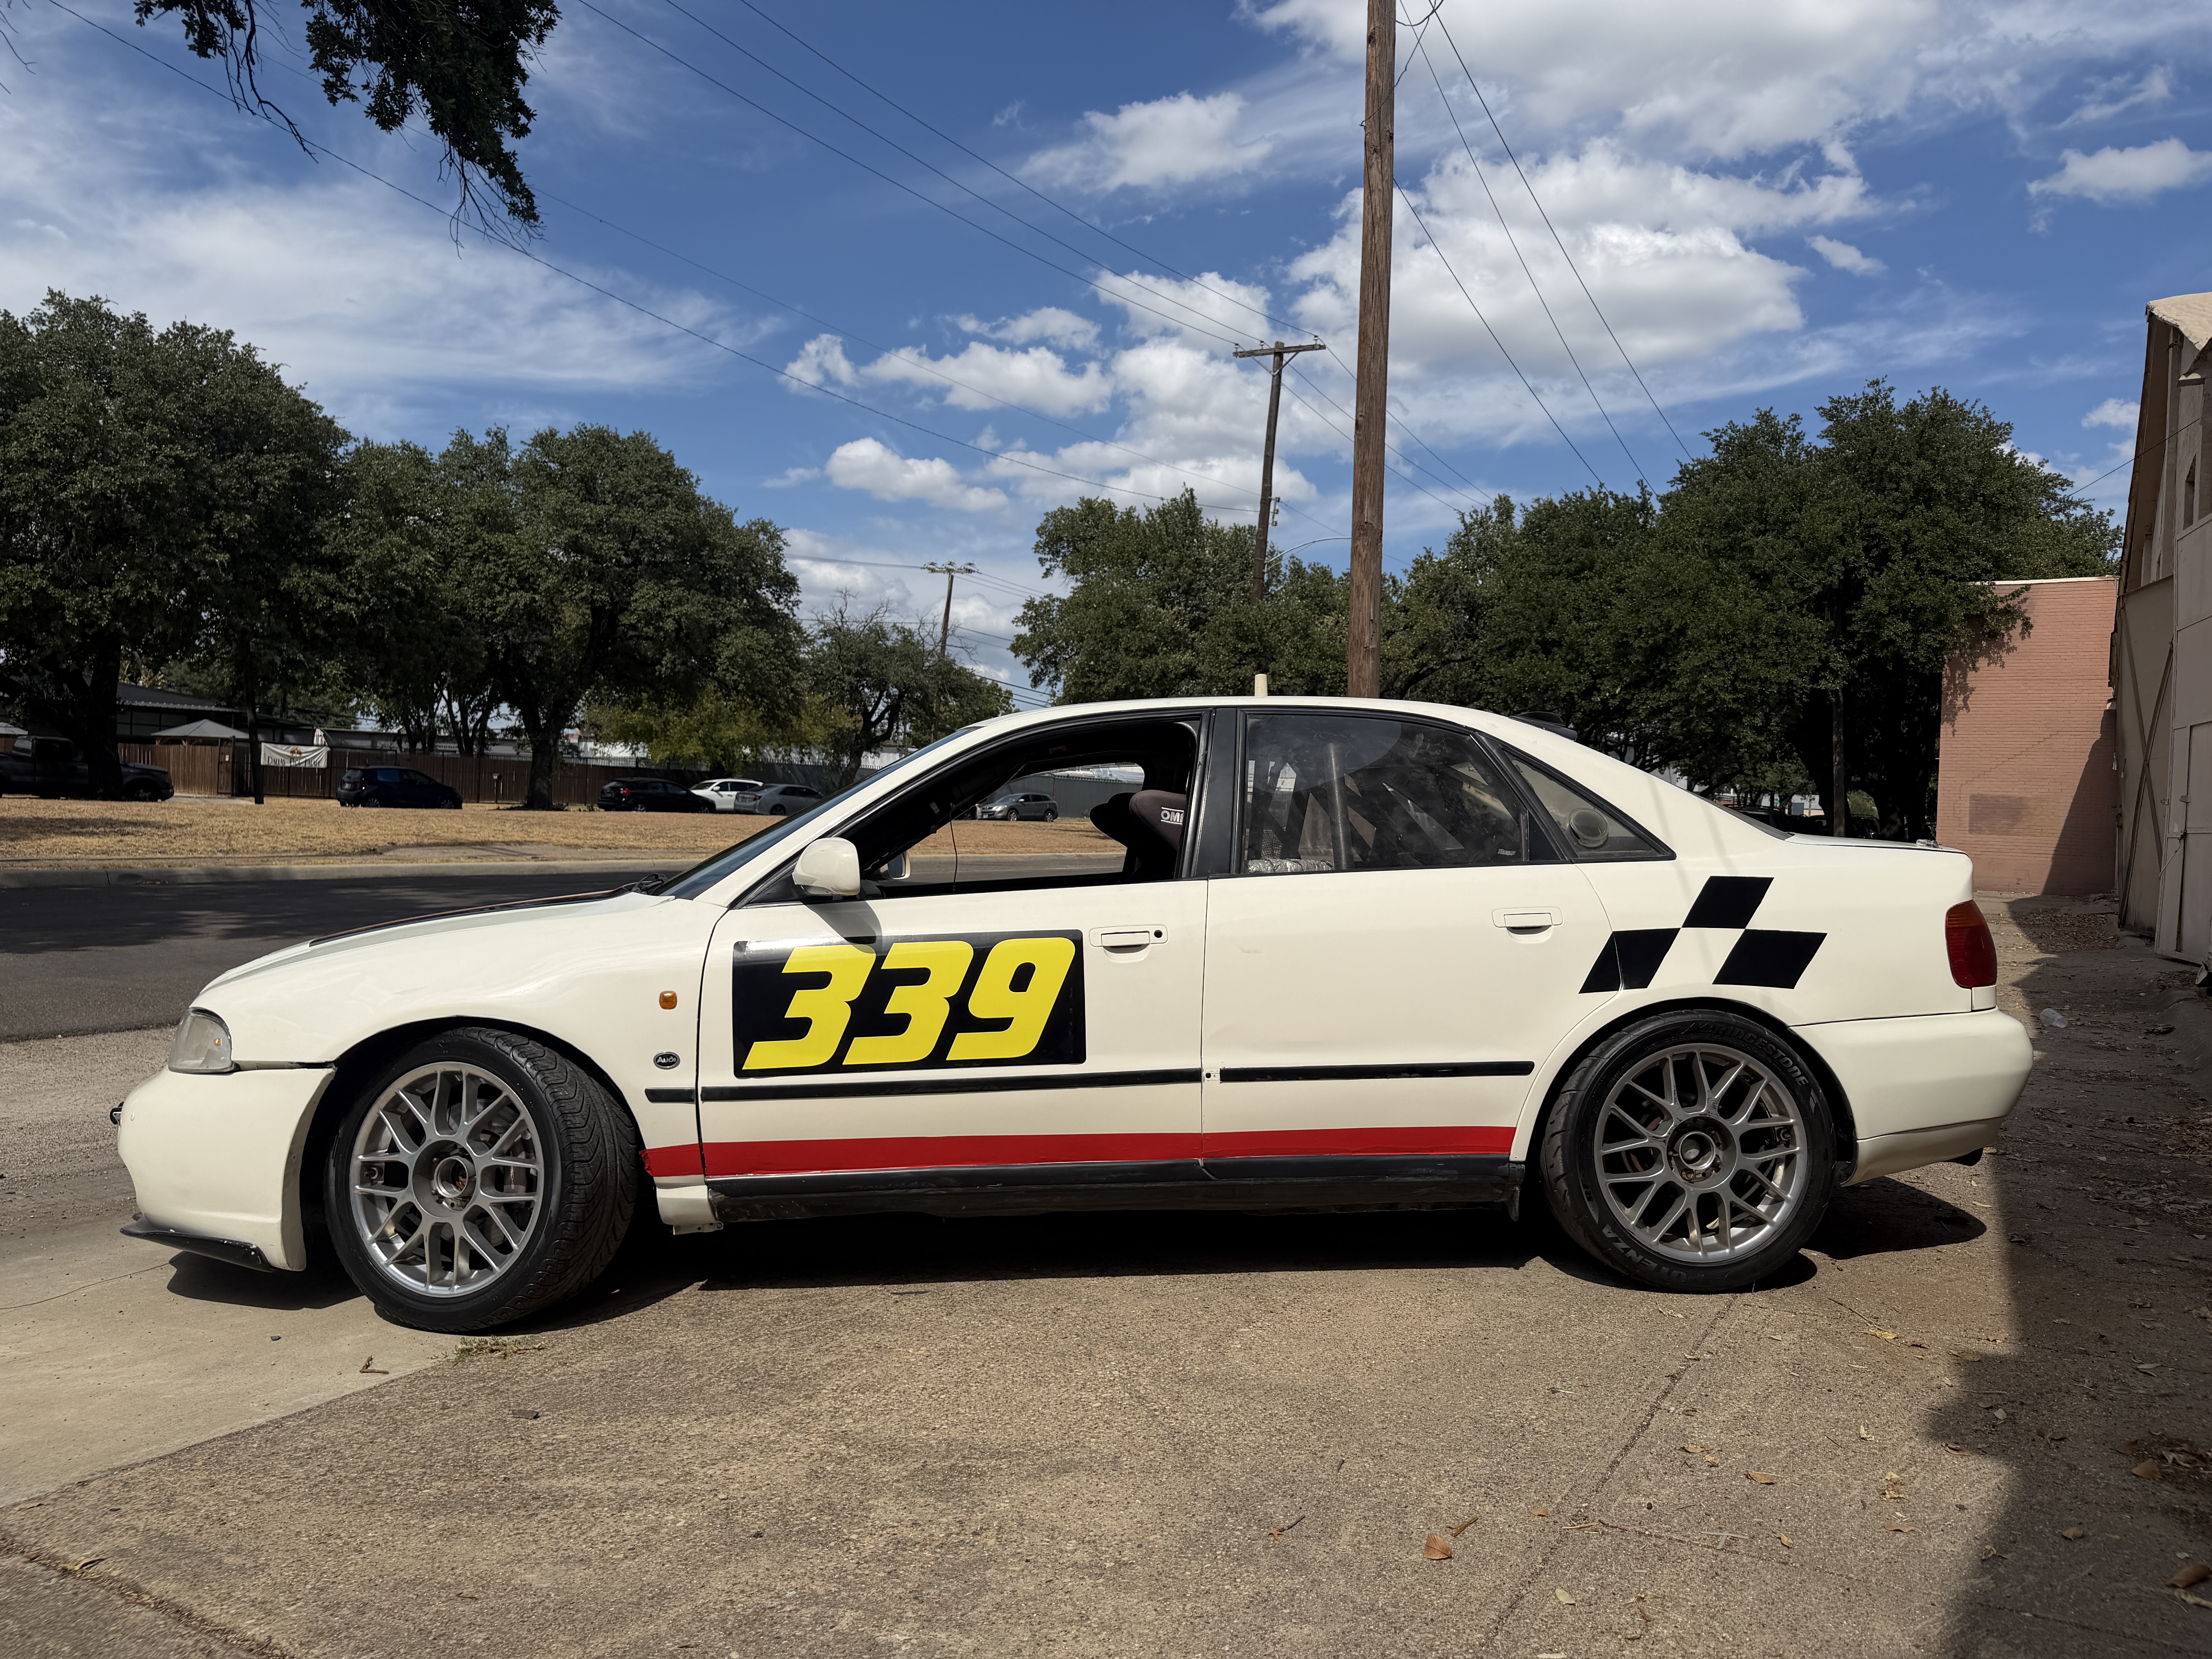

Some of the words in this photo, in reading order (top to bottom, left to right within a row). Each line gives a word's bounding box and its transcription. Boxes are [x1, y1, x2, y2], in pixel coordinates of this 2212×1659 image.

[742, 937, 1075, 1070] 339
[1697, 1022, 1809, 1086] BRIDGESTONE
[1602, 1223, 1704, 1283] POTENZA
